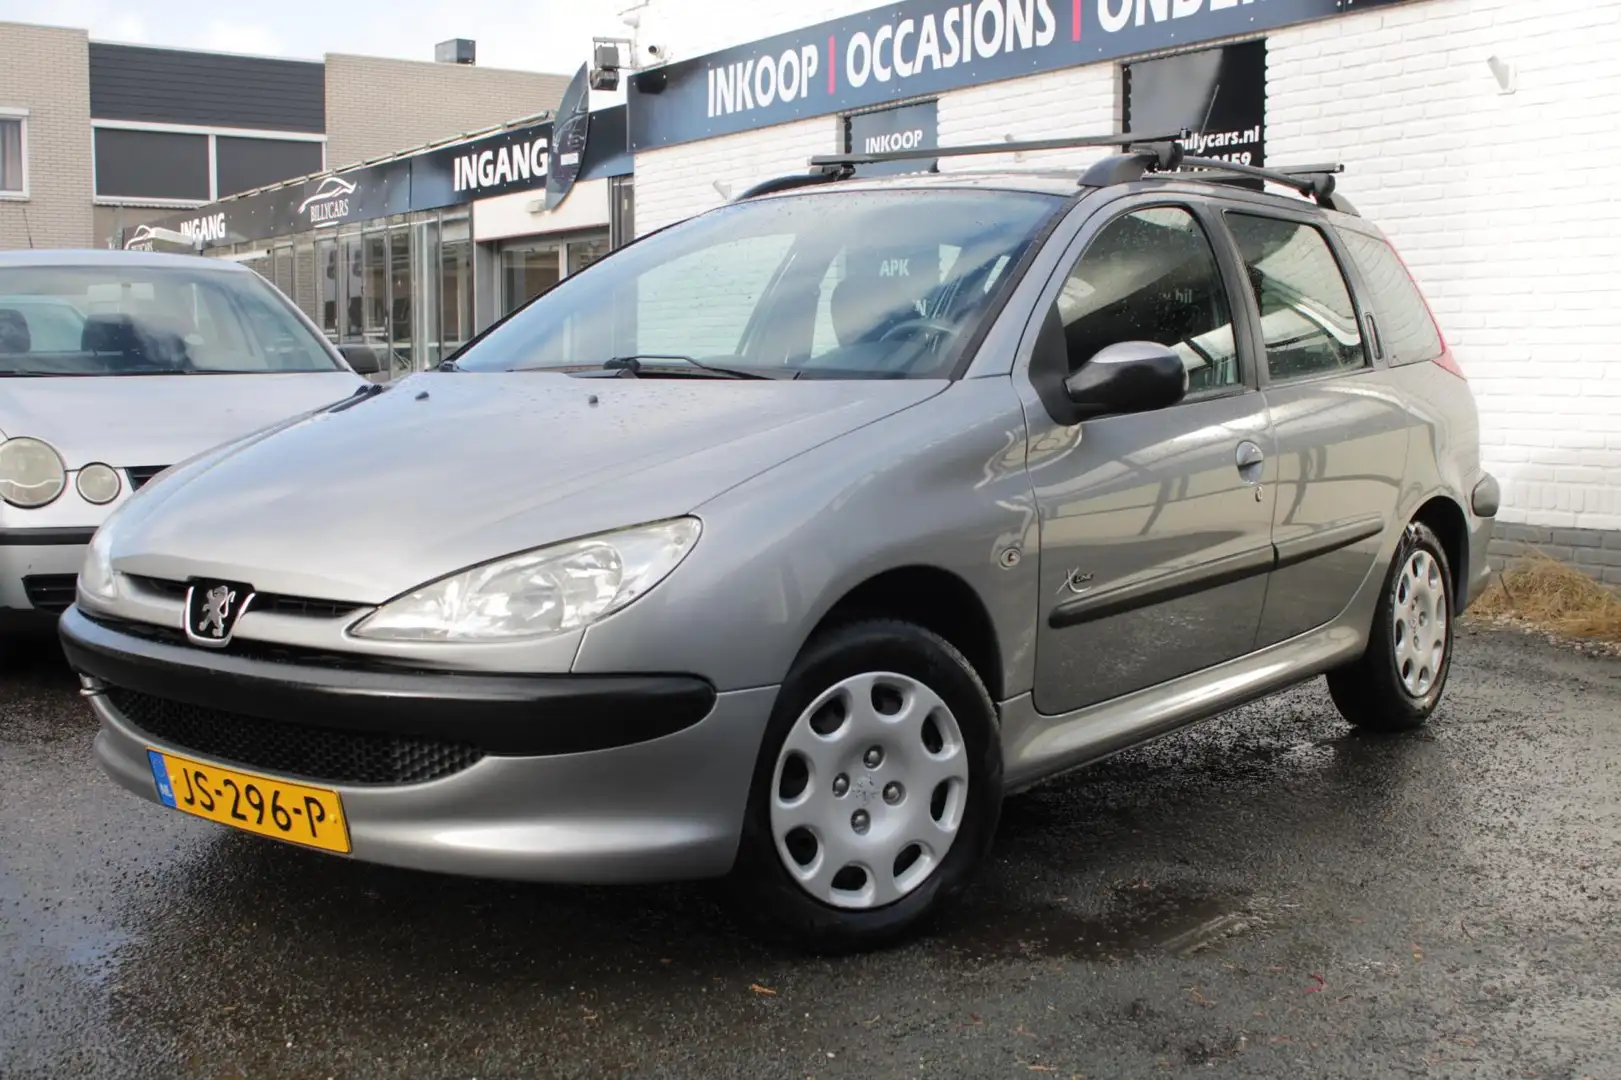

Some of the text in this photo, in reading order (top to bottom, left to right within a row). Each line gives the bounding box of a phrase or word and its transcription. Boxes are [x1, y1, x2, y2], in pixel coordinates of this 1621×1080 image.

[708, 0, 1056, 117] INKOOP OCCASIONS
[865, 130, 922, 154] INKOOP
[1175, 125, 1260, 152] illycars.nl
[454, 138, 549, 191] INGANG
[310, 198, 349, 222] BILLYCARS
[180, 212, 225, 241] INGANG
[879, 257, 910, 277] APK
[183, 768, 326, 838] JS-296-P
